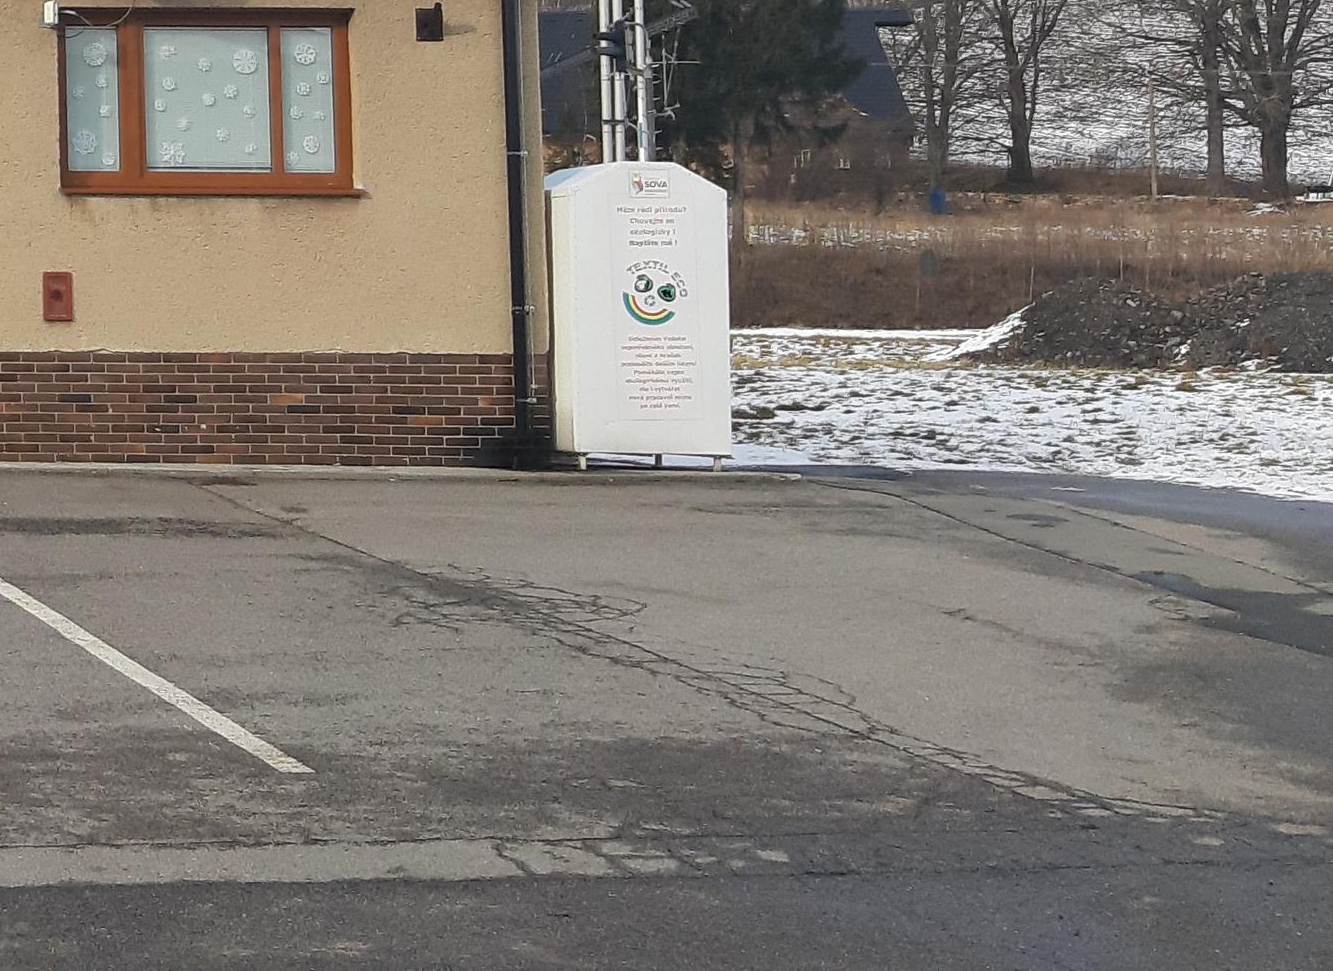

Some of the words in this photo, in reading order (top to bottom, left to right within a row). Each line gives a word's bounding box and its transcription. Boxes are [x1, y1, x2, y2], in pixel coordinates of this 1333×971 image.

[644, 180, 668, 189] SOVA
[626, 260, 670, 275] TEXTIL
[670, 271, 689, 298] ECO
